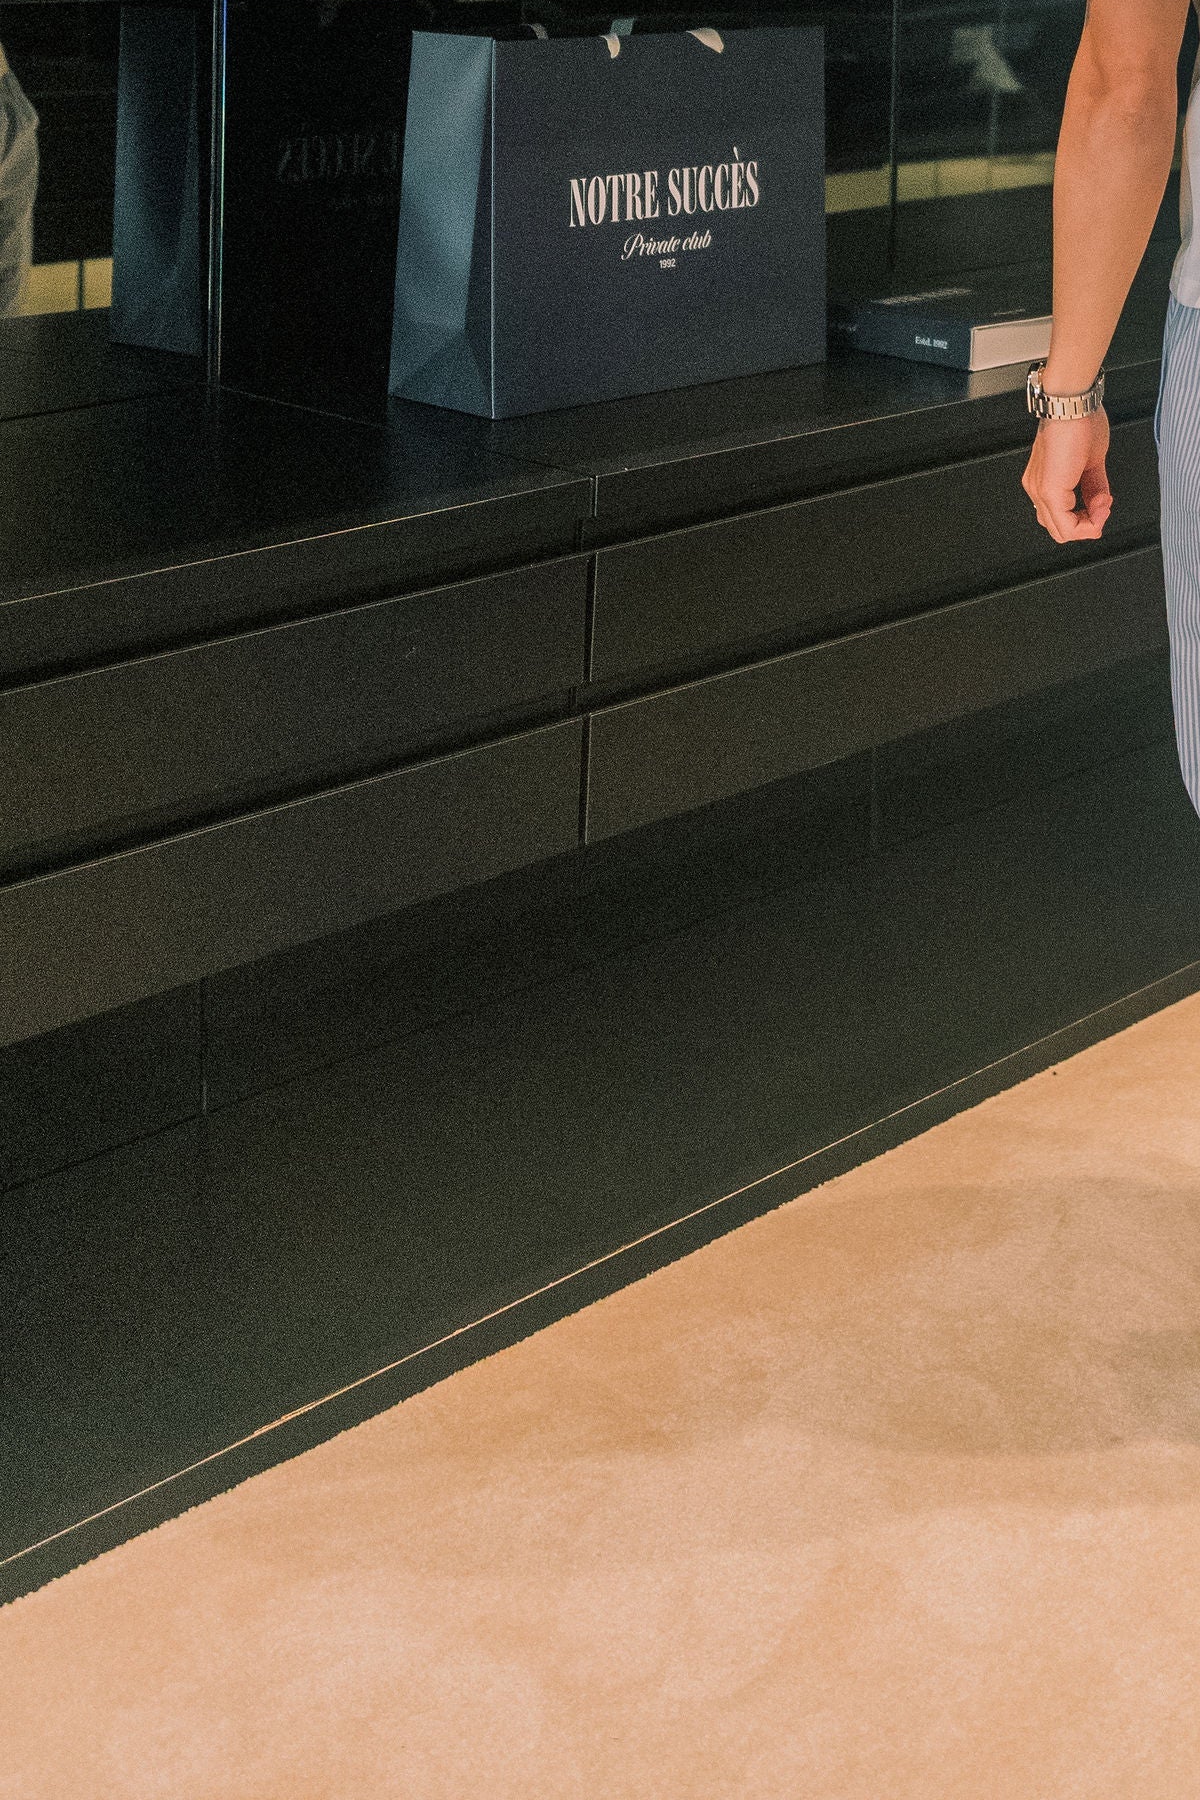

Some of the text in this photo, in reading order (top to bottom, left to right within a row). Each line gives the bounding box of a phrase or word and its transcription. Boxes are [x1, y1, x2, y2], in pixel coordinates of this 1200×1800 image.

[569, 146, 760, 228] NOTRE SUCCÈS
[621, 229, 712, 261] Private club
[659, 258, 676, 269] 1992
